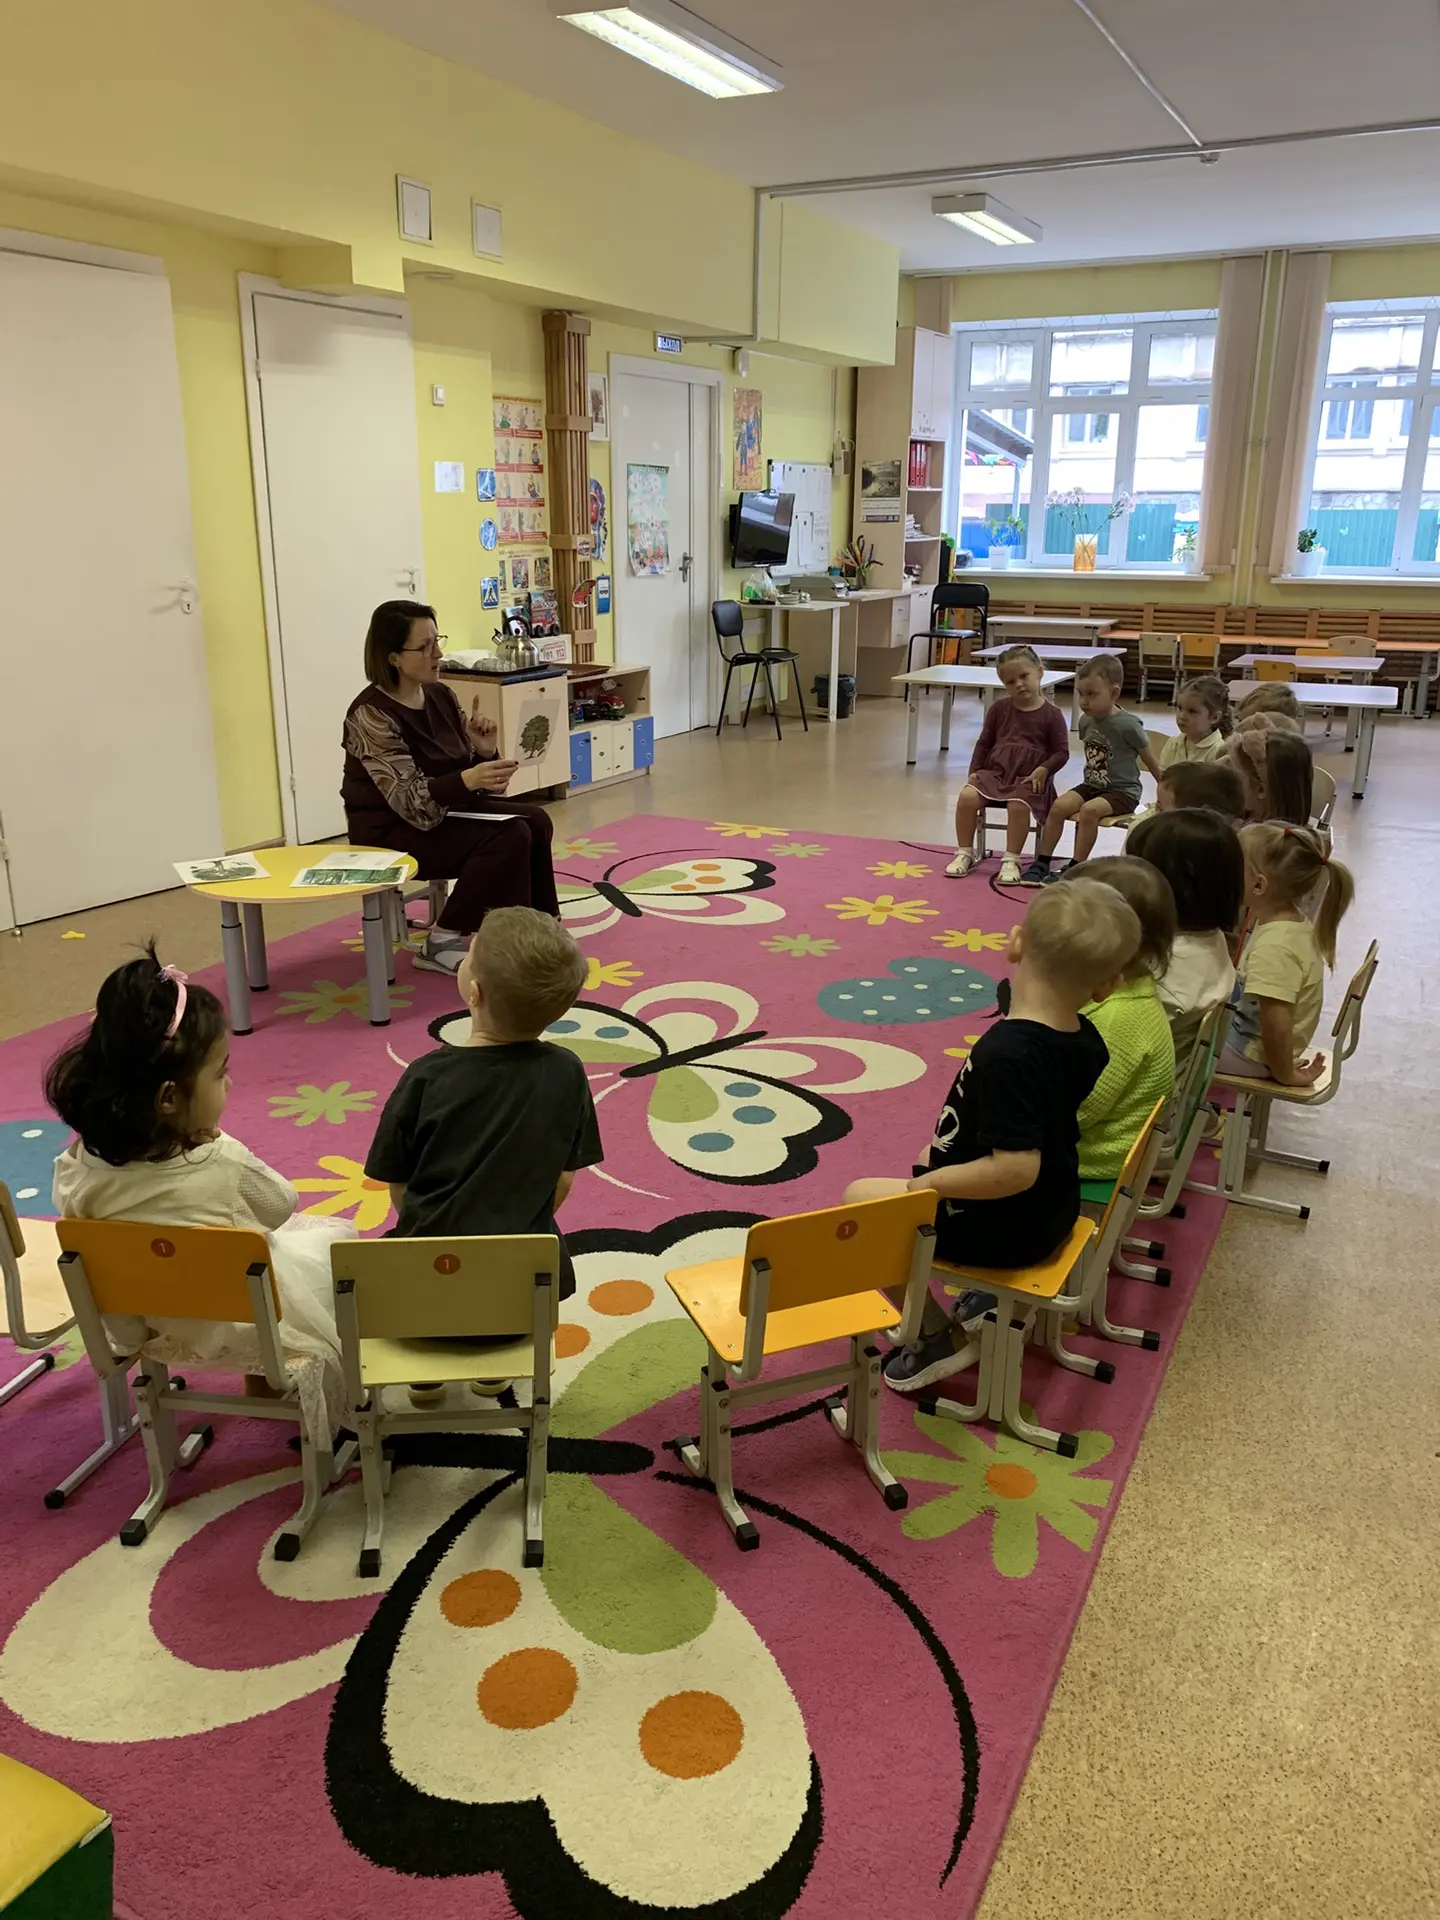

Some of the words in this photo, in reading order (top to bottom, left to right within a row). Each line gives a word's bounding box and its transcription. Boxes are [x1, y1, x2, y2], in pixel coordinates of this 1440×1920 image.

[658, 336, 681, 352] ВЫХОД
[844, 1225, 849, 1236] 1
[160, 1242, 166, 1253] 1
[444, 1259, 449, 1270] 1
